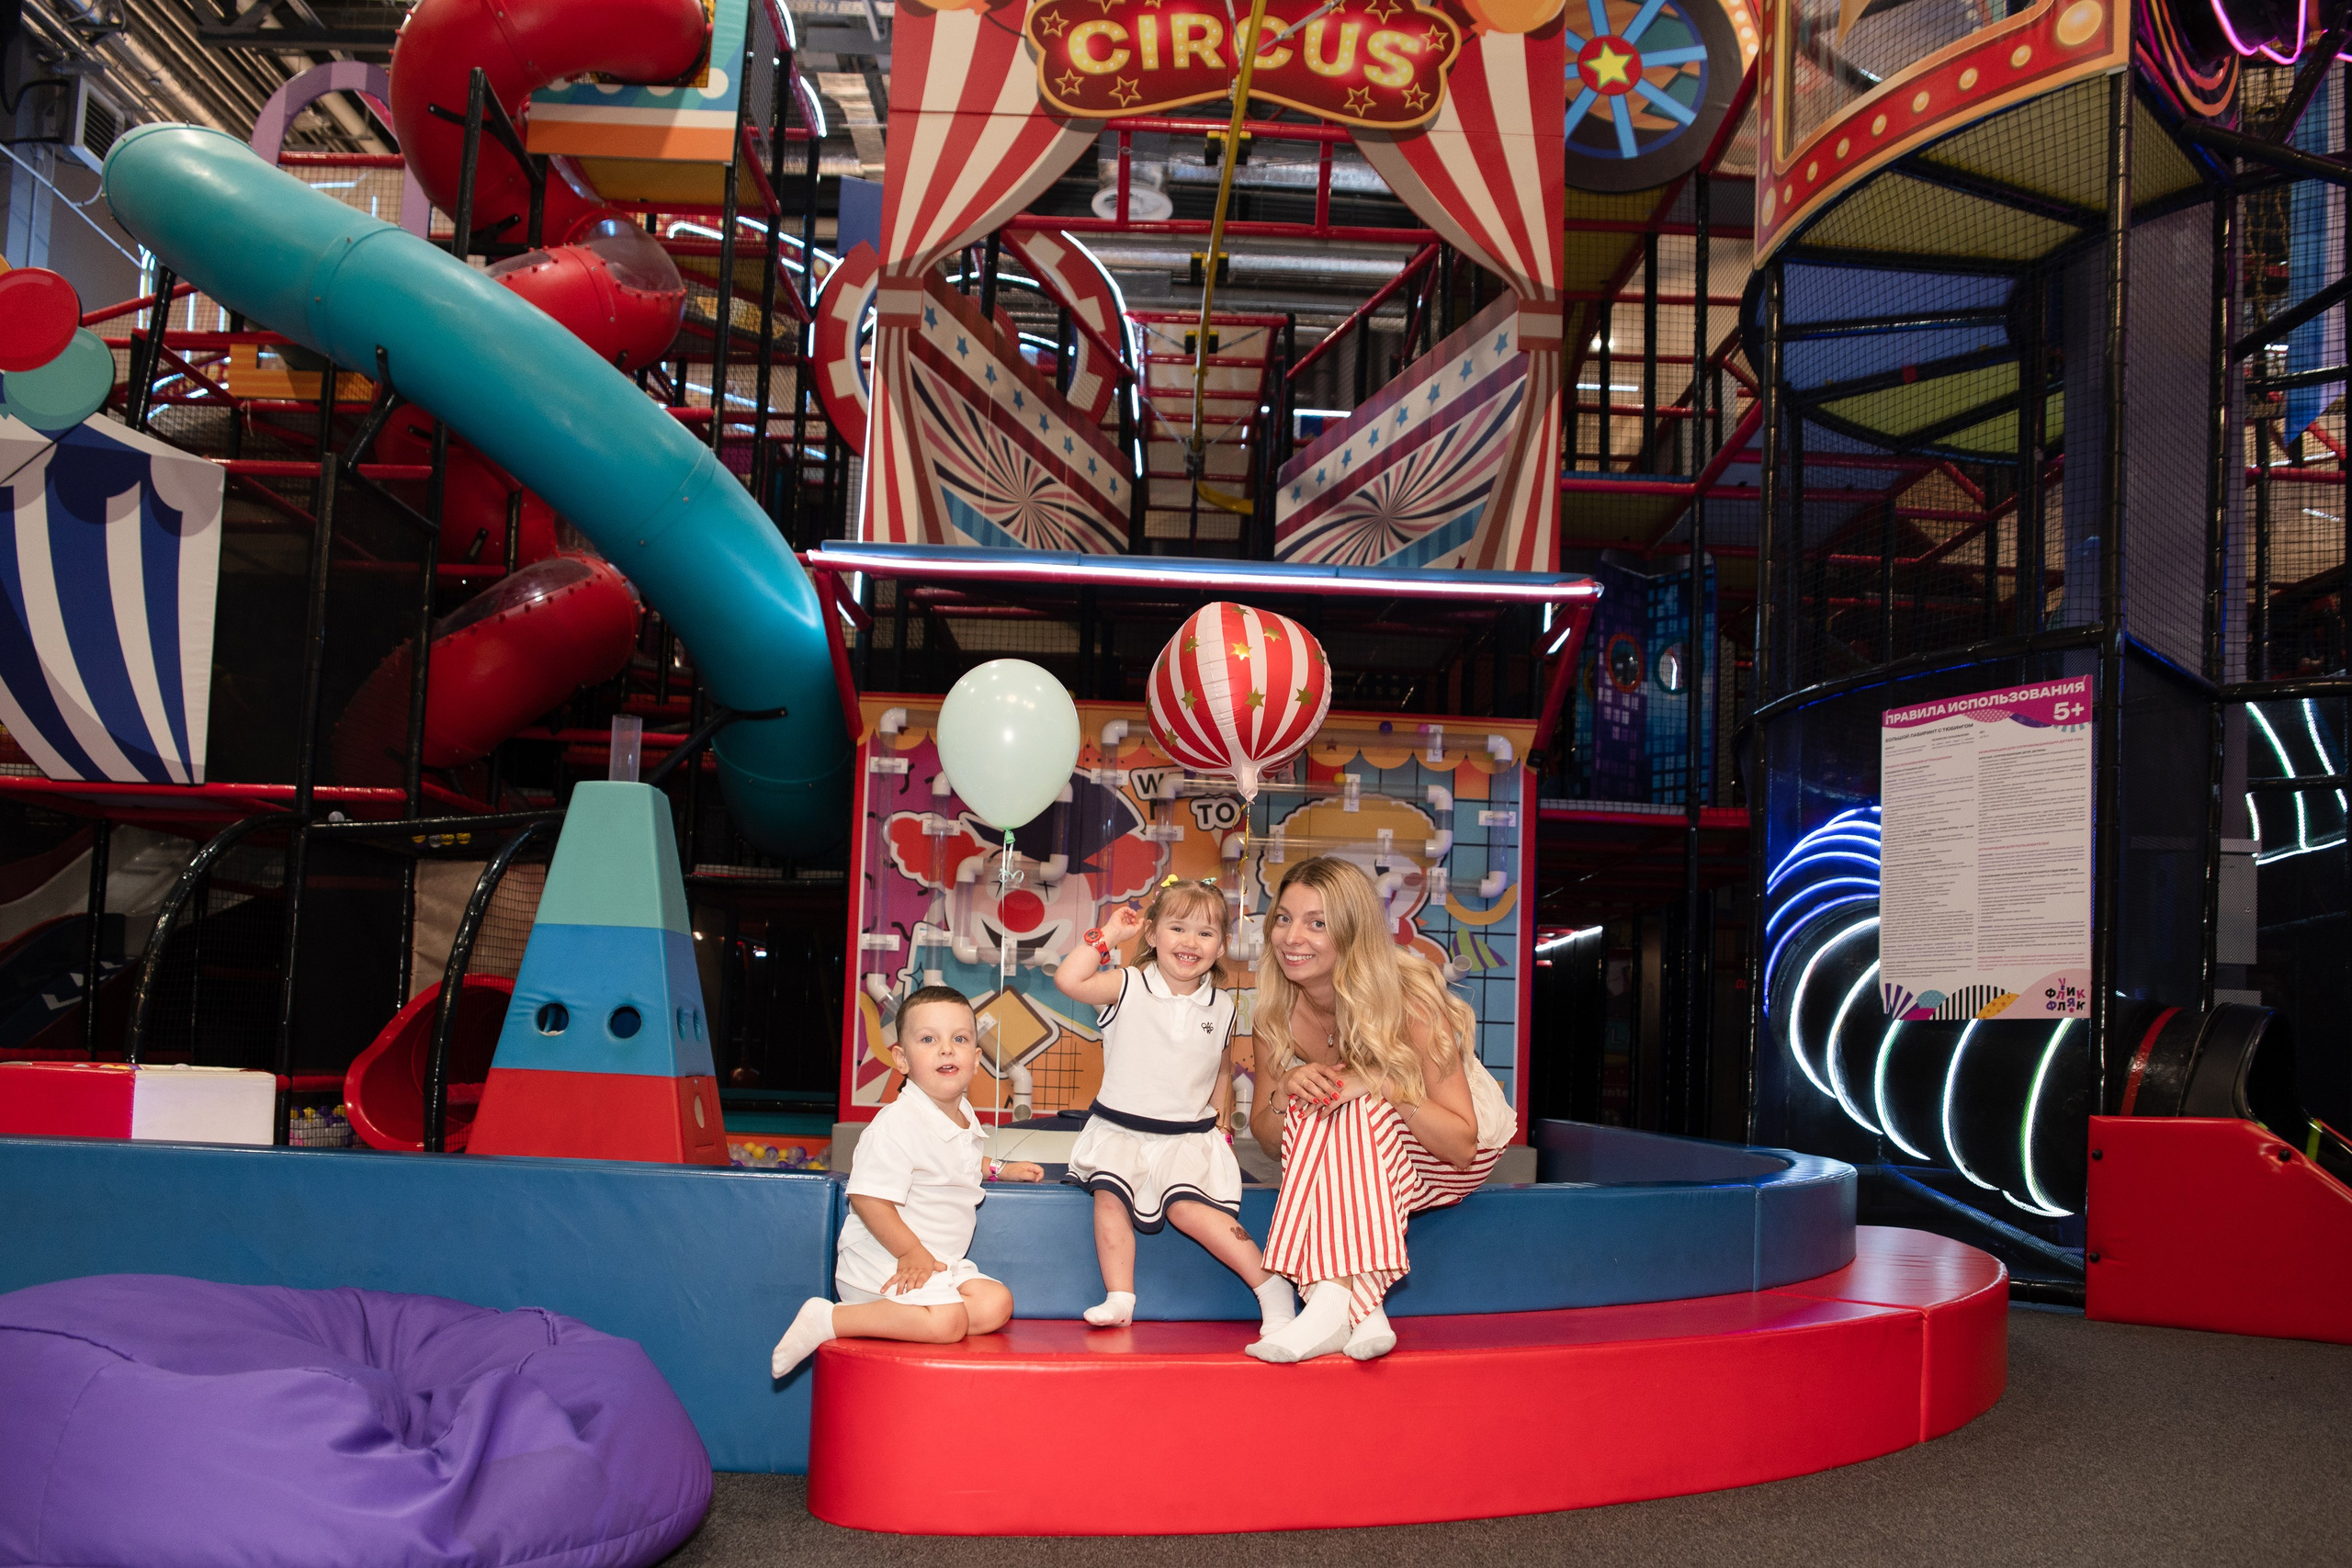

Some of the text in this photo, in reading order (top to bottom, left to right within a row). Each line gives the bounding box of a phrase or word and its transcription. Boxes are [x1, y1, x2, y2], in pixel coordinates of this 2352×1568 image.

[1068, 13, 1421, 88] CIRCUS
[1885, 681, 2085, 725] ПРАВИЛА ИСПОЛЬЗОВАНИЯ
[2053, 702, 2085, 721] 5+
[1197, 802, 1235, 824] TO
[2045, 987, 2086, 1000] ФЛИК
[2046, 998, 2086, 1011] ФЛЯК
